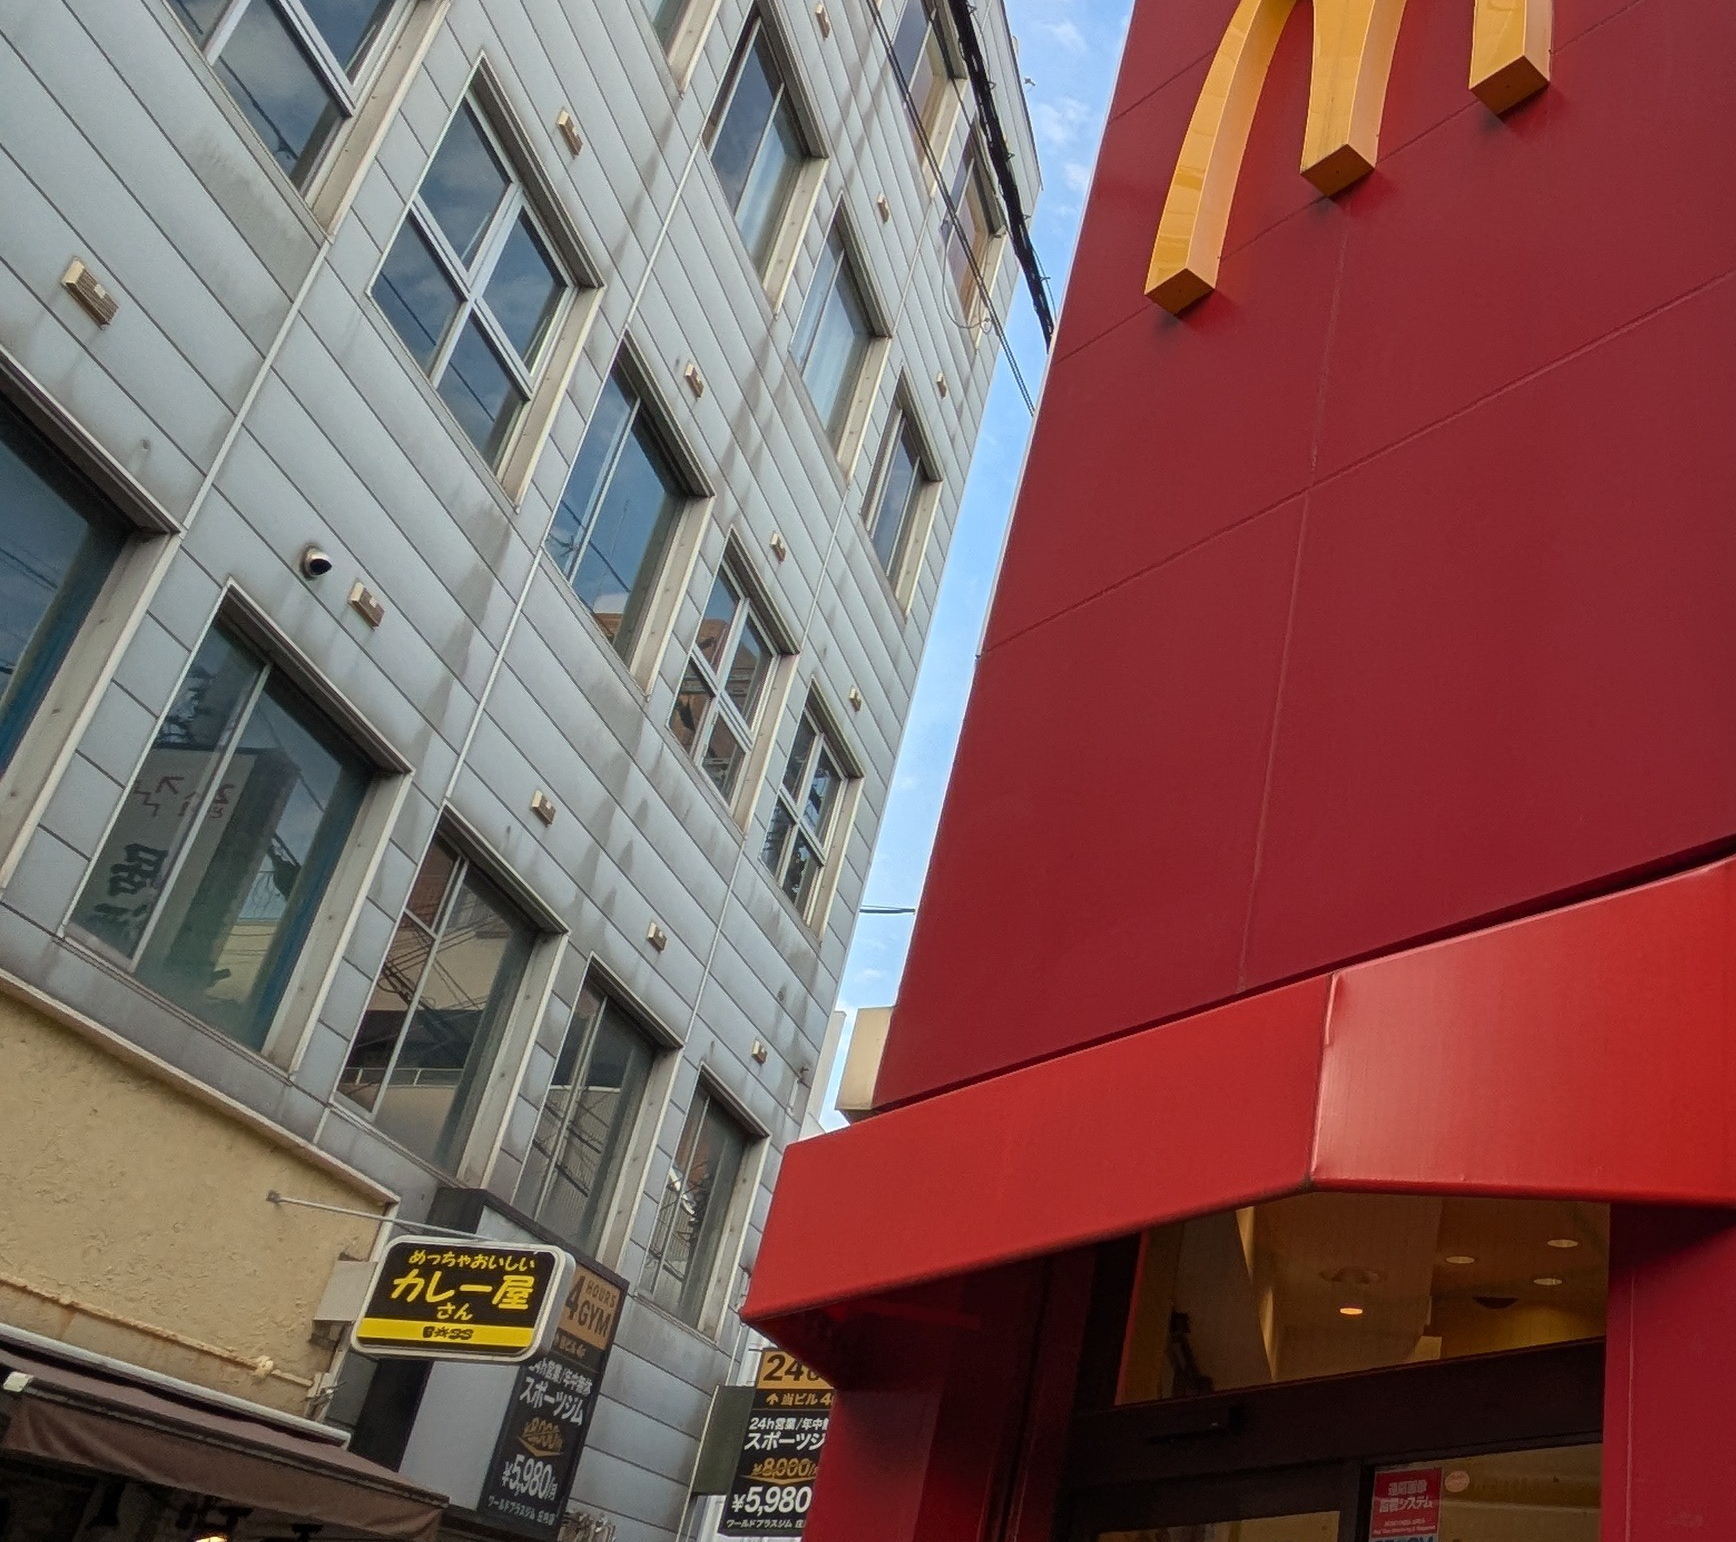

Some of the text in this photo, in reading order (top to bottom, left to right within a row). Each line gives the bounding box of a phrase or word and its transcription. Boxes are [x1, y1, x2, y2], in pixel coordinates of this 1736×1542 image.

[409, 1250, 535, 1271] めっちゃおいしい
[391, 1269, 535, 1309] カレー屋
[584, 1276, 616, 1309] HOURS
[437, 1302, 473, 1320] さん
[578, 1301, 610, 1338] GYM
[519, 1376, 584, 1426] スポーツジム
[820, 1393, 834, 1405] 4
[731, 1486, 812, 1516] ¥5,980
